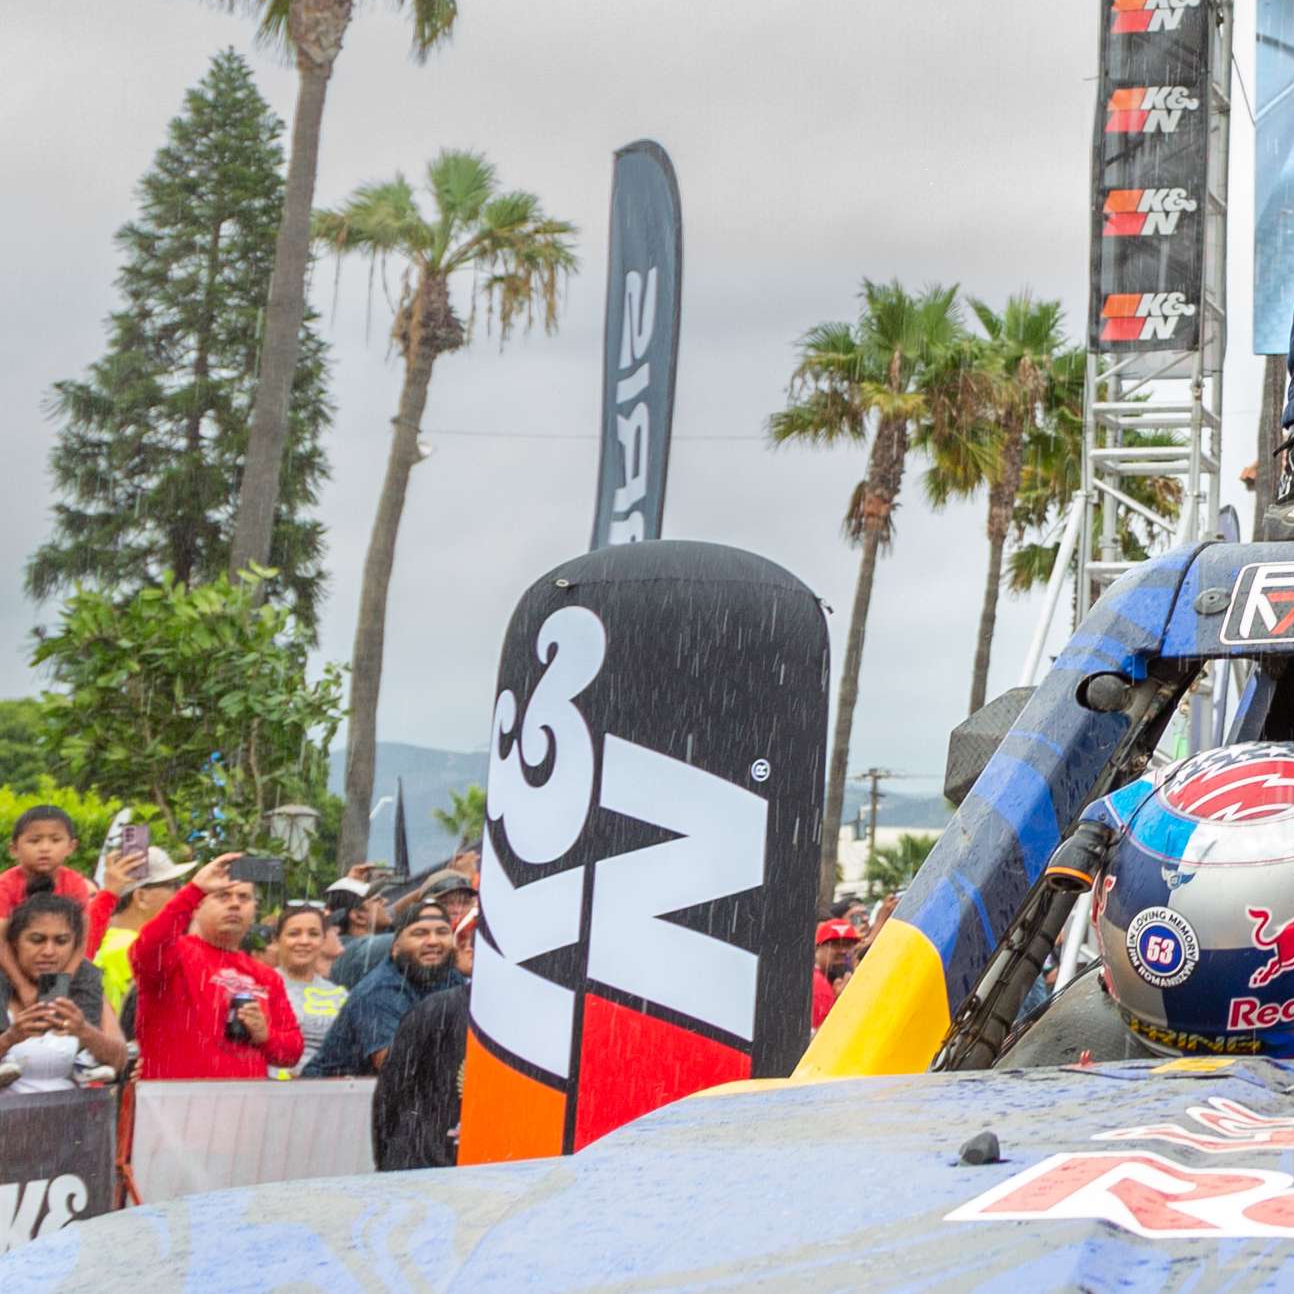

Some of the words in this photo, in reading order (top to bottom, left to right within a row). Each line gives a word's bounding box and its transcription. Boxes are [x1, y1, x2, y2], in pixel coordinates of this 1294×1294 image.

[1134, 909, 1168, 933] LOVING
[1168, 912, 1198, 961] MEMORY
[1146, 935, 1175, 965] 53
